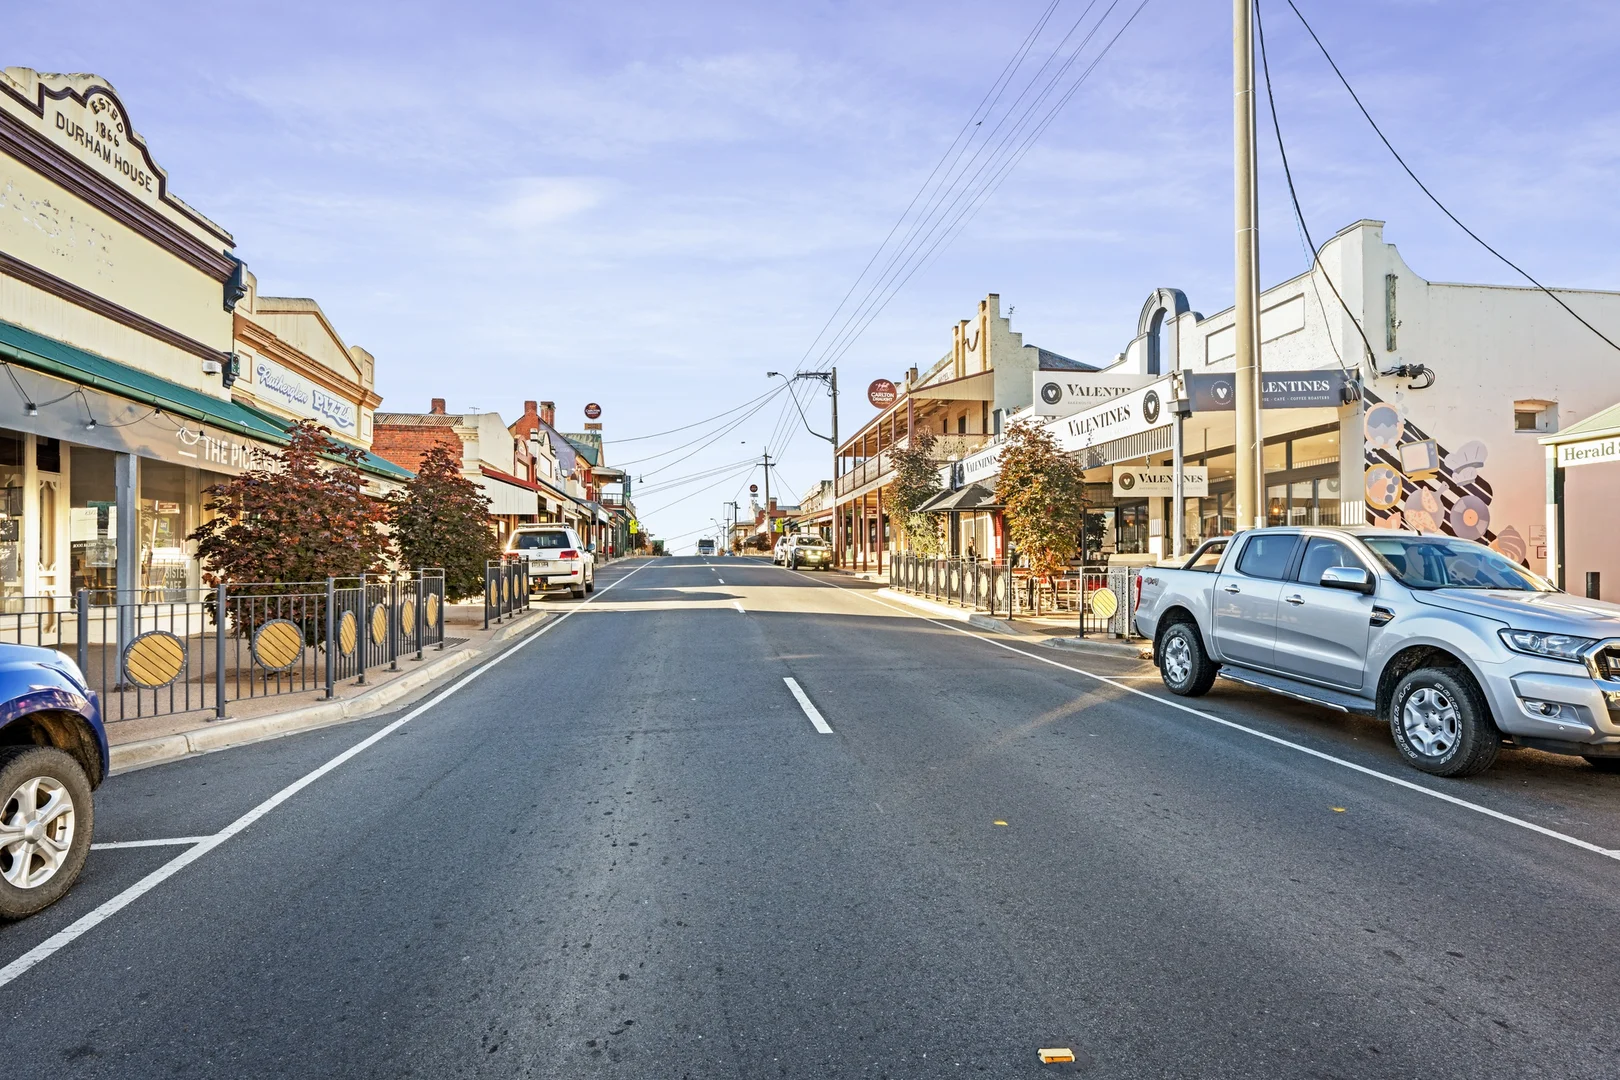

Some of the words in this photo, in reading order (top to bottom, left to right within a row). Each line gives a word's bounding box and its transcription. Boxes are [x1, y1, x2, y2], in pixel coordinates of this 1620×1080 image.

[96, 120, 119, 147] 1866
[56, 110, 111, 164] DURHAM
[114, 153, 153, 193] HOUSE
[1067, 384, 1131, 397] VALENTI
[1262, 380, 1330, 393] LENTINES
[312, 389, 355, 425] PIZZA
[1068, 404, 1131, 437] VALENTINES
[203, 435, 228, 464] THE
[1564, 441, 1615, 461] Herald
[1139, 473, 1203, 483] VALENNES
[1394, 705, 1418, 759] DUELER
